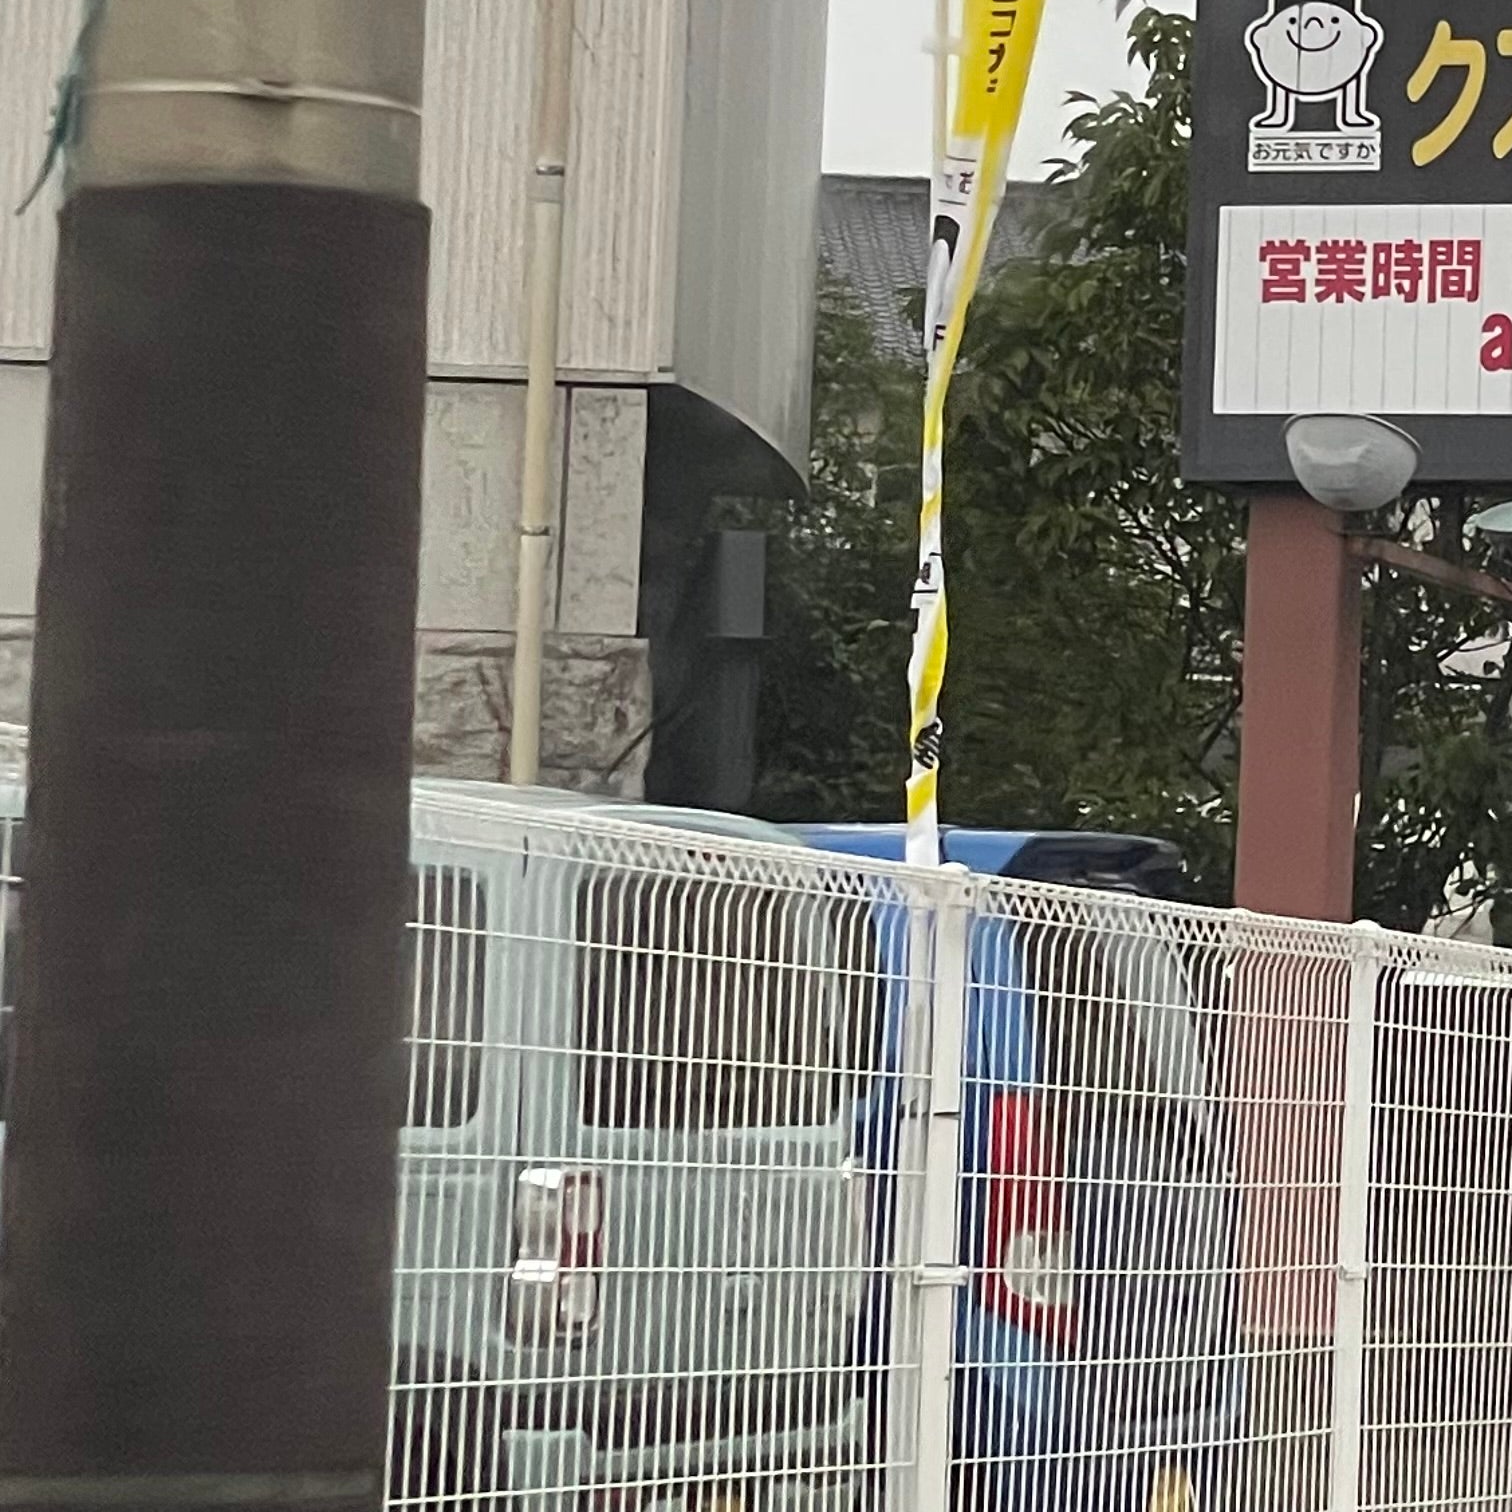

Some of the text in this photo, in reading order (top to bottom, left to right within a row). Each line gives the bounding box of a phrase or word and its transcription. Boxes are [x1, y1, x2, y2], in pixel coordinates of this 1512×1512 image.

[1252, 141, 1376, 161] お元気ですか
[1259, 240, 1481, 303] 営業時間
